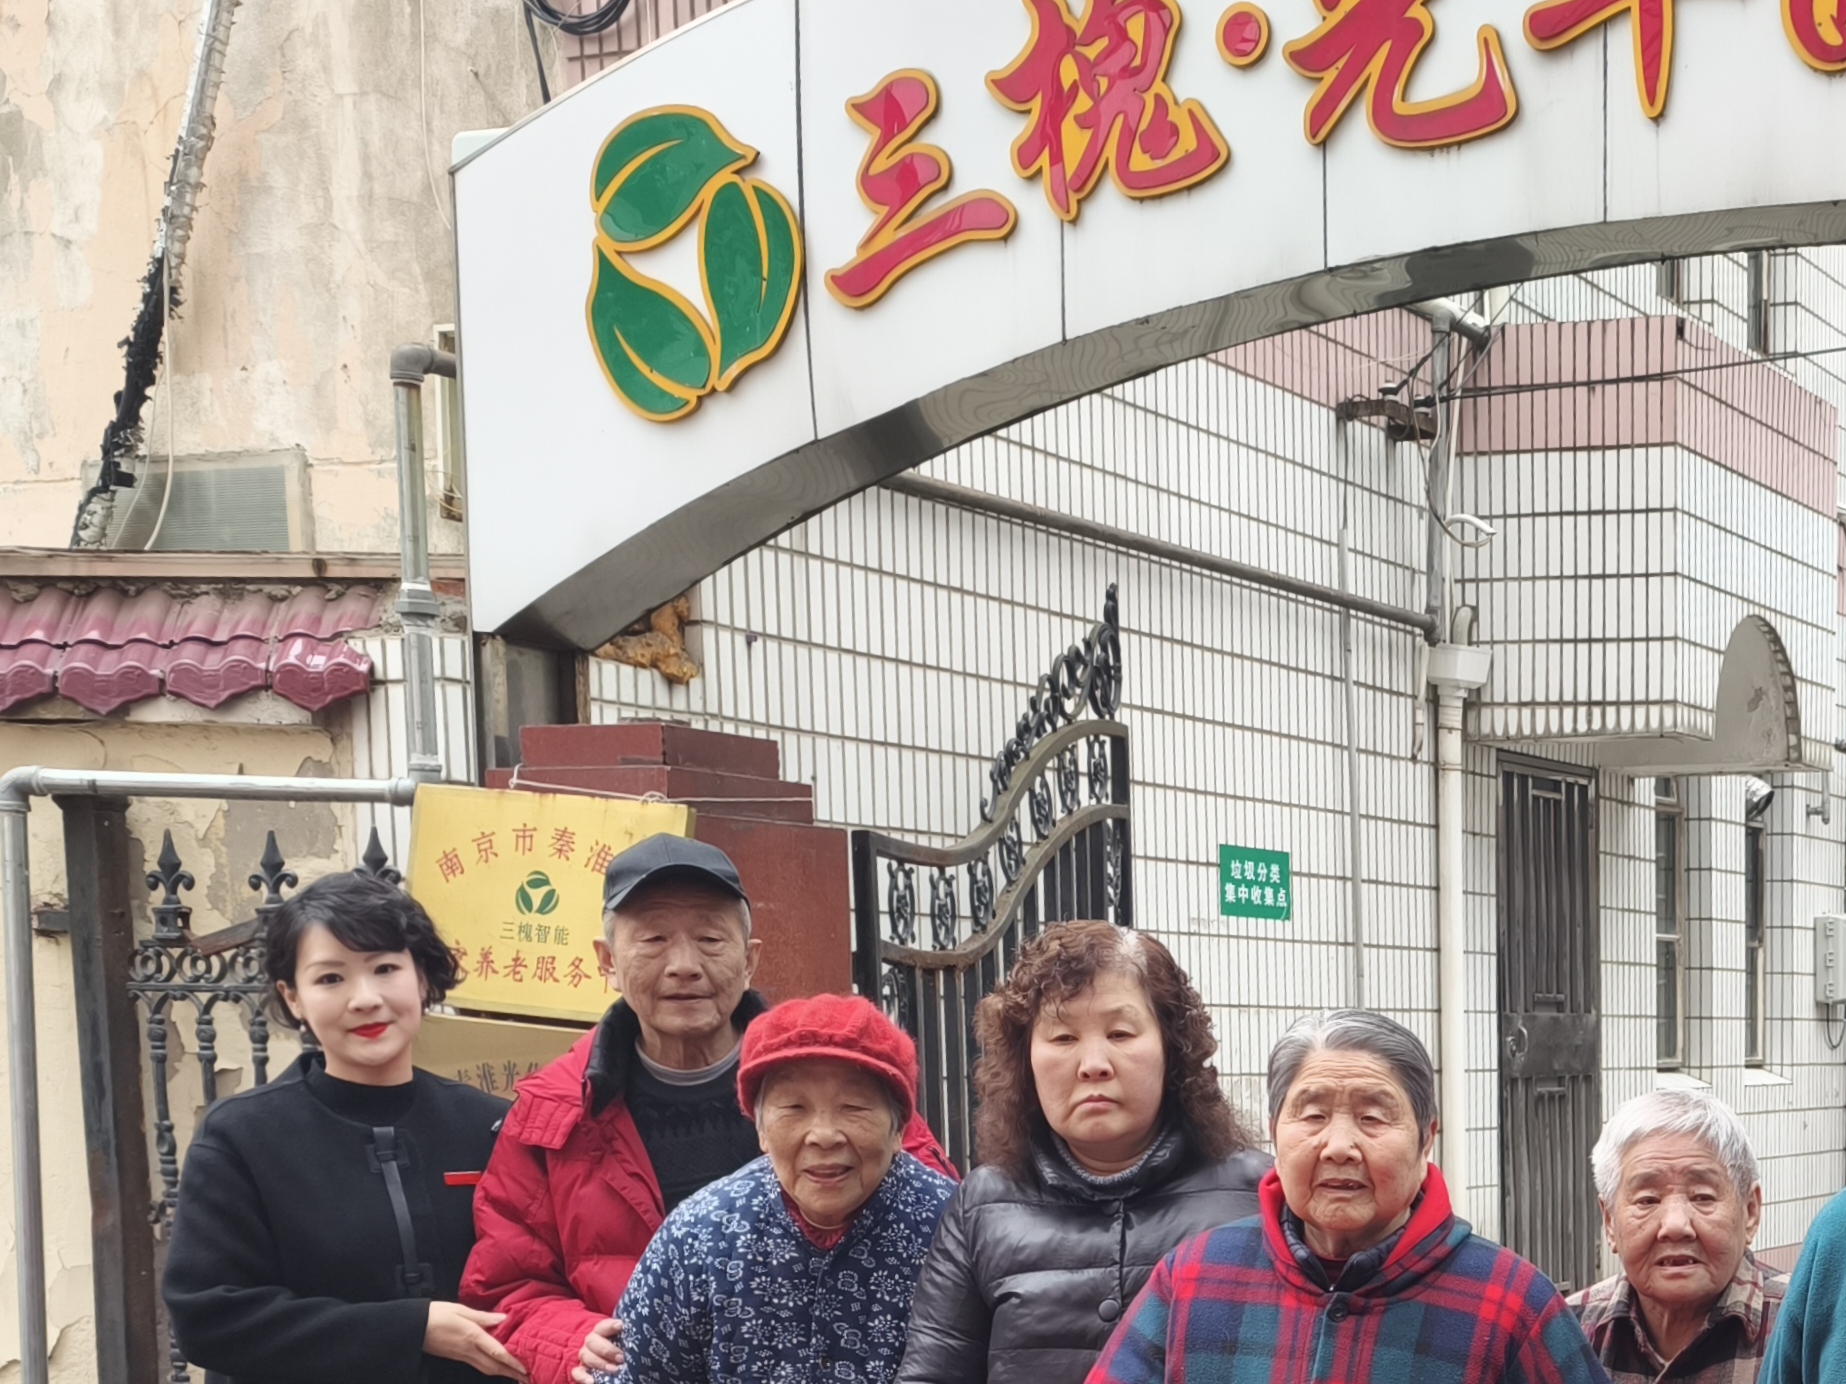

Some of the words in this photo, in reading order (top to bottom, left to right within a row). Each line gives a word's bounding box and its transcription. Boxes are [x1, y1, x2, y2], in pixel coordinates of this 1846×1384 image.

[1230, 860, 1280, 883] 垃圾分类
[1224, 883, 1287, 907] 集中收集点
[500, 921, 570, 946] 三槐智能
